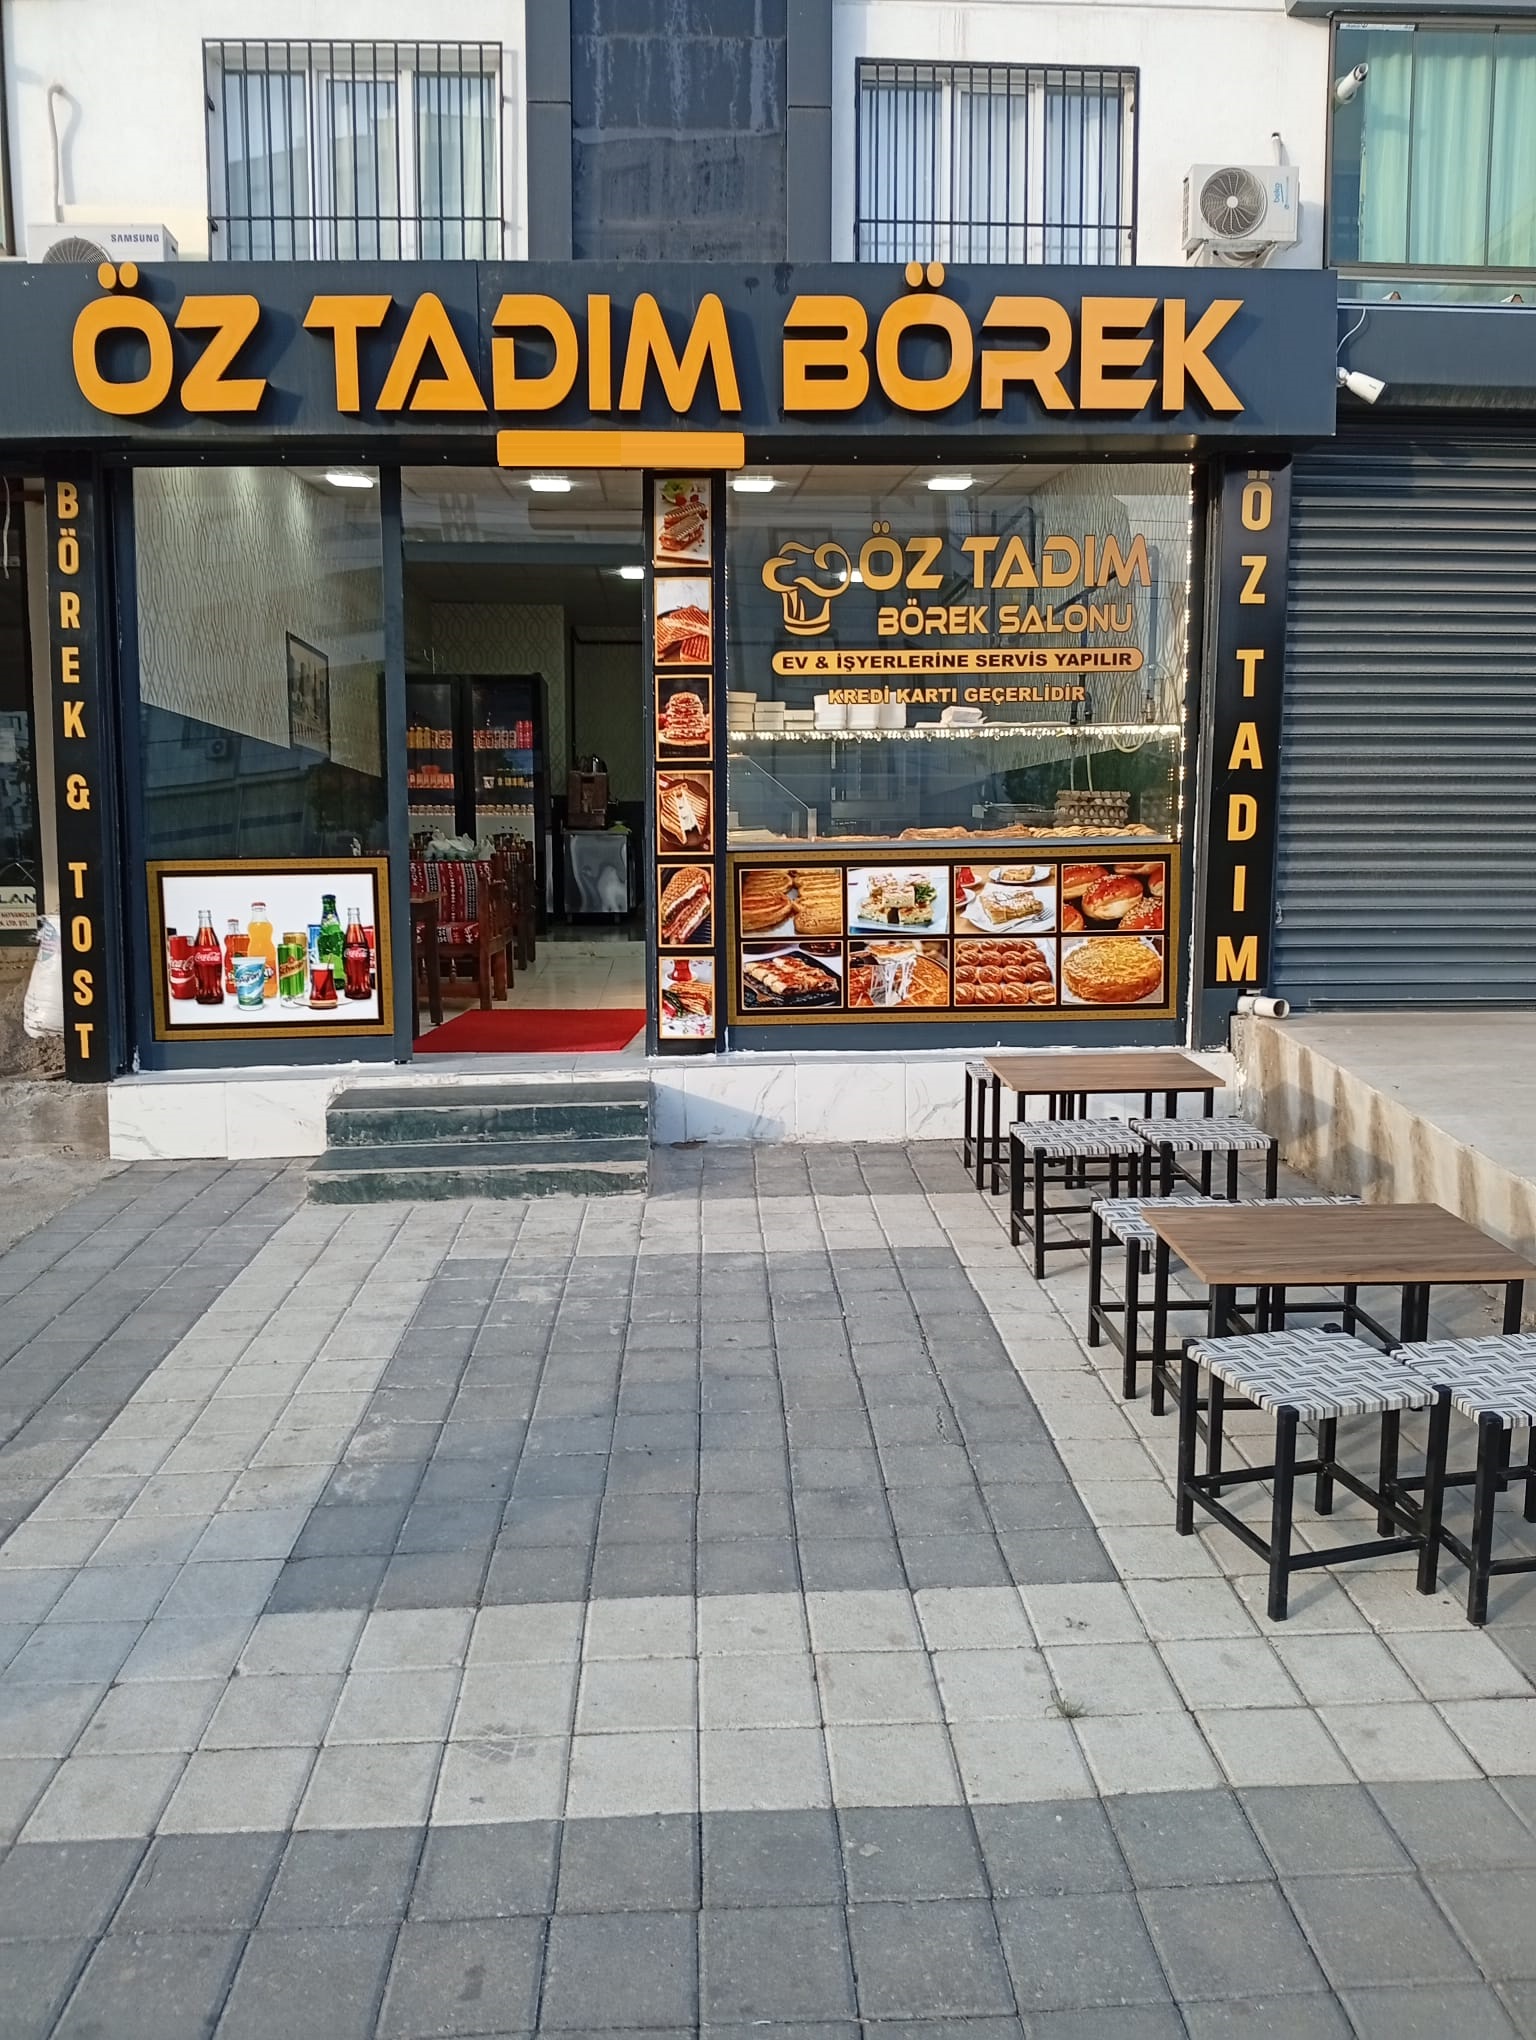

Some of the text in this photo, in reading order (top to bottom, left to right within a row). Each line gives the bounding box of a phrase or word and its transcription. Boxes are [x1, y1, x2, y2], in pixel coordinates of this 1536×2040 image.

[110, 233, 160, 243] SAMSUNG
[72, 261, 1245, 415] ÖZ TADIM BÖREK
[858, 520, 1152, 591] ÖZ TADIM
[876, 598, 1133, 636] BÖREK SALONU
[782, 651, 1133, 673] EV & İŞYERLERİNE SERVİS YAPILIR
[828, 685, 1086, 706] KREDİ KARTI GEÇERLİDİR
[1215, 469, 1273, 983] ÖZ TADIM
[57, 481, 95, 1060] BÖREK & TOST
